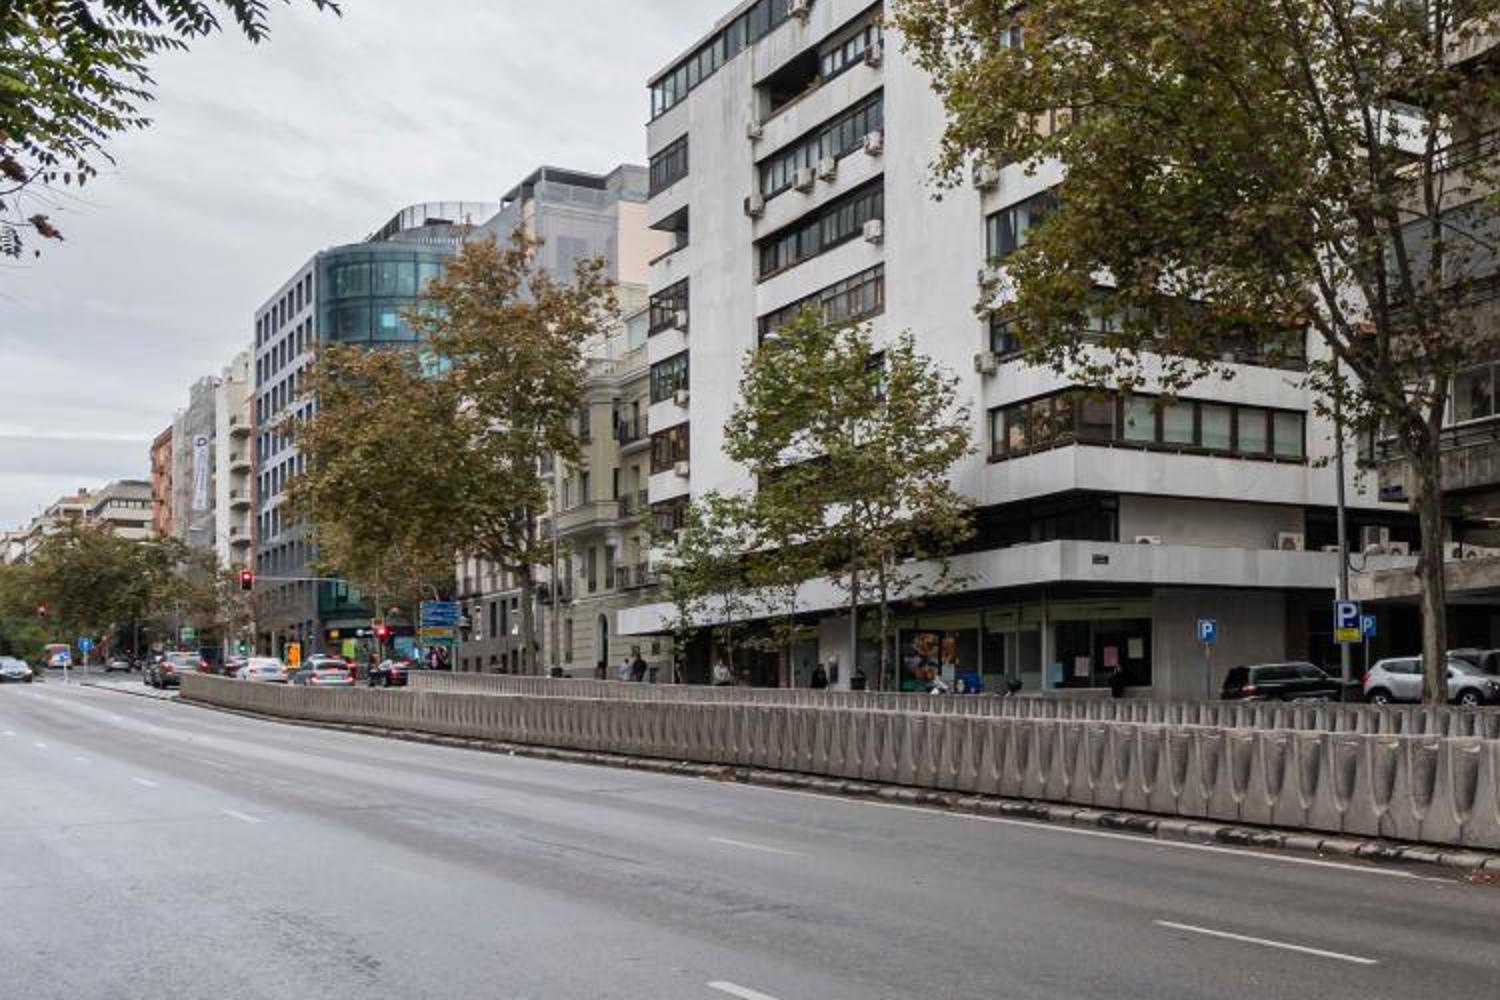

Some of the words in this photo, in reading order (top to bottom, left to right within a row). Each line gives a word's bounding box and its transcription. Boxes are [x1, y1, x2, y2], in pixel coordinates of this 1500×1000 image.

[1338, 603, 1357, 627] P
[1202, 622, 1212, 638] P
[1364, 617, 1373, 632] P
